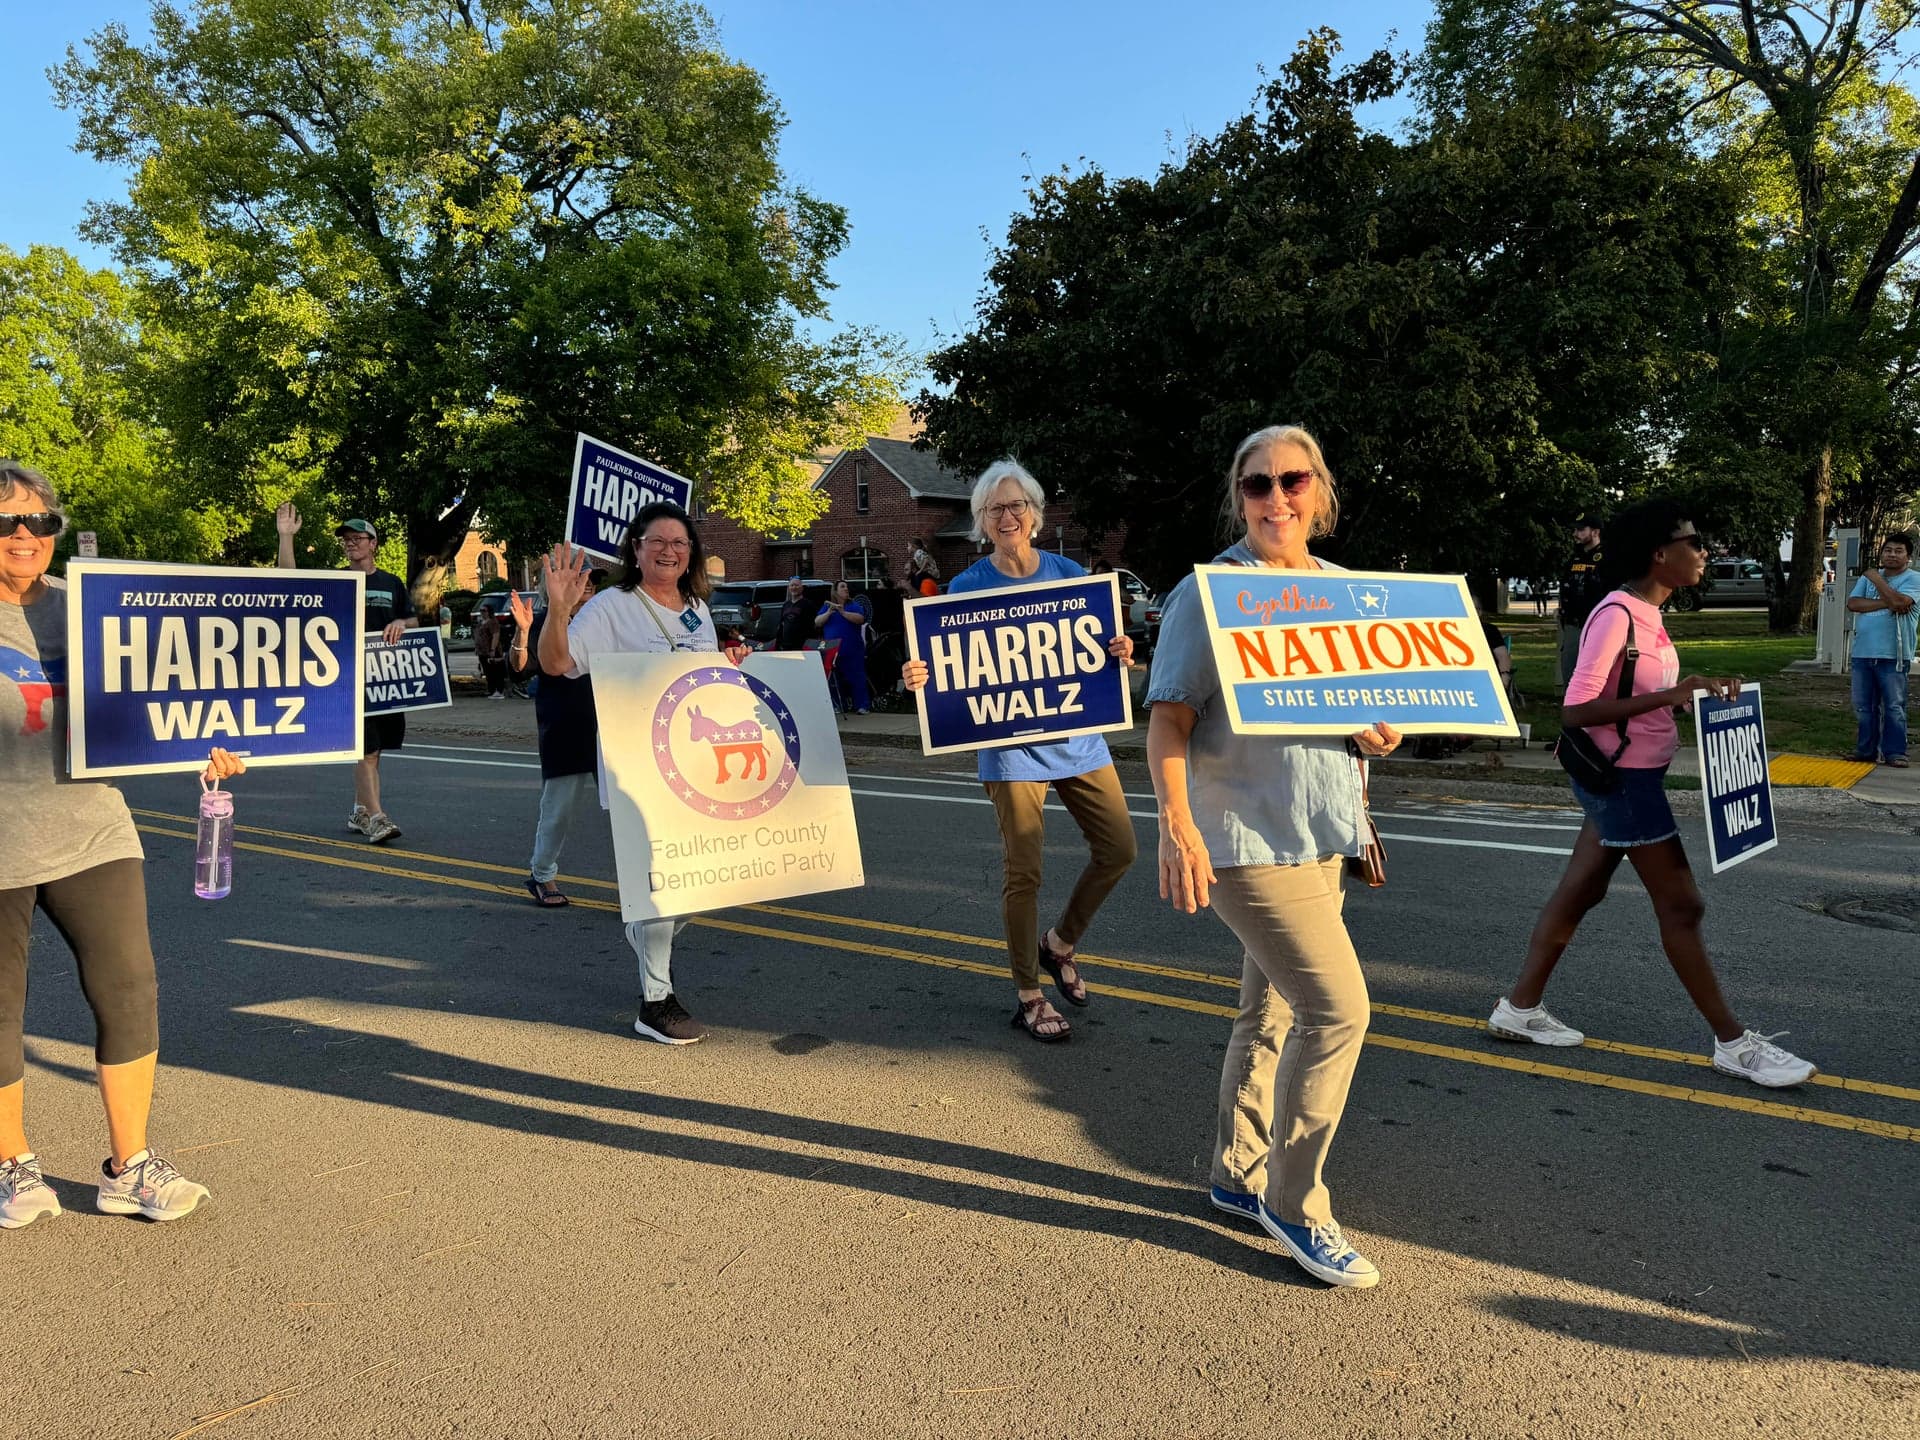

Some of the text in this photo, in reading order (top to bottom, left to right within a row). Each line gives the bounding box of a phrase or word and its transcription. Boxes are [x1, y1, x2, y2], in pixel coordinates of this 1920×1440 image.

[583, 465, 679, 523] HAR
[595, 455, 675, 494] FAULKNER COUNTY FOR
[120, 592, 323, 608] FAULKNER COUNTY FOR
[940, 597, 1087, 627] FAULKNER COUNTY FOR
[1236, 584, 1336, 625] Cynthia
[102, 616, 340, 693] HARRIS
[366, 646, 437, 683] ARRIS
[929, 614, 1106, 693] HARRIS
[1230, 620, 1475, 679] NATIONS
[366, 680, 427, 703] WALZ
[966, 682, 1084, 726] WALZ
[1263, 689, 1478, 708] STATE REPRESENTATIVE
[147, 696, 306, 741] WALZ
[1706, 722, 1764, 799] HARRIS
[1723, 793, 1762, 838] WALZ
[649, 822, 828, 862] Faulkner County
[648, 850, 836, 892] Democratic Party
